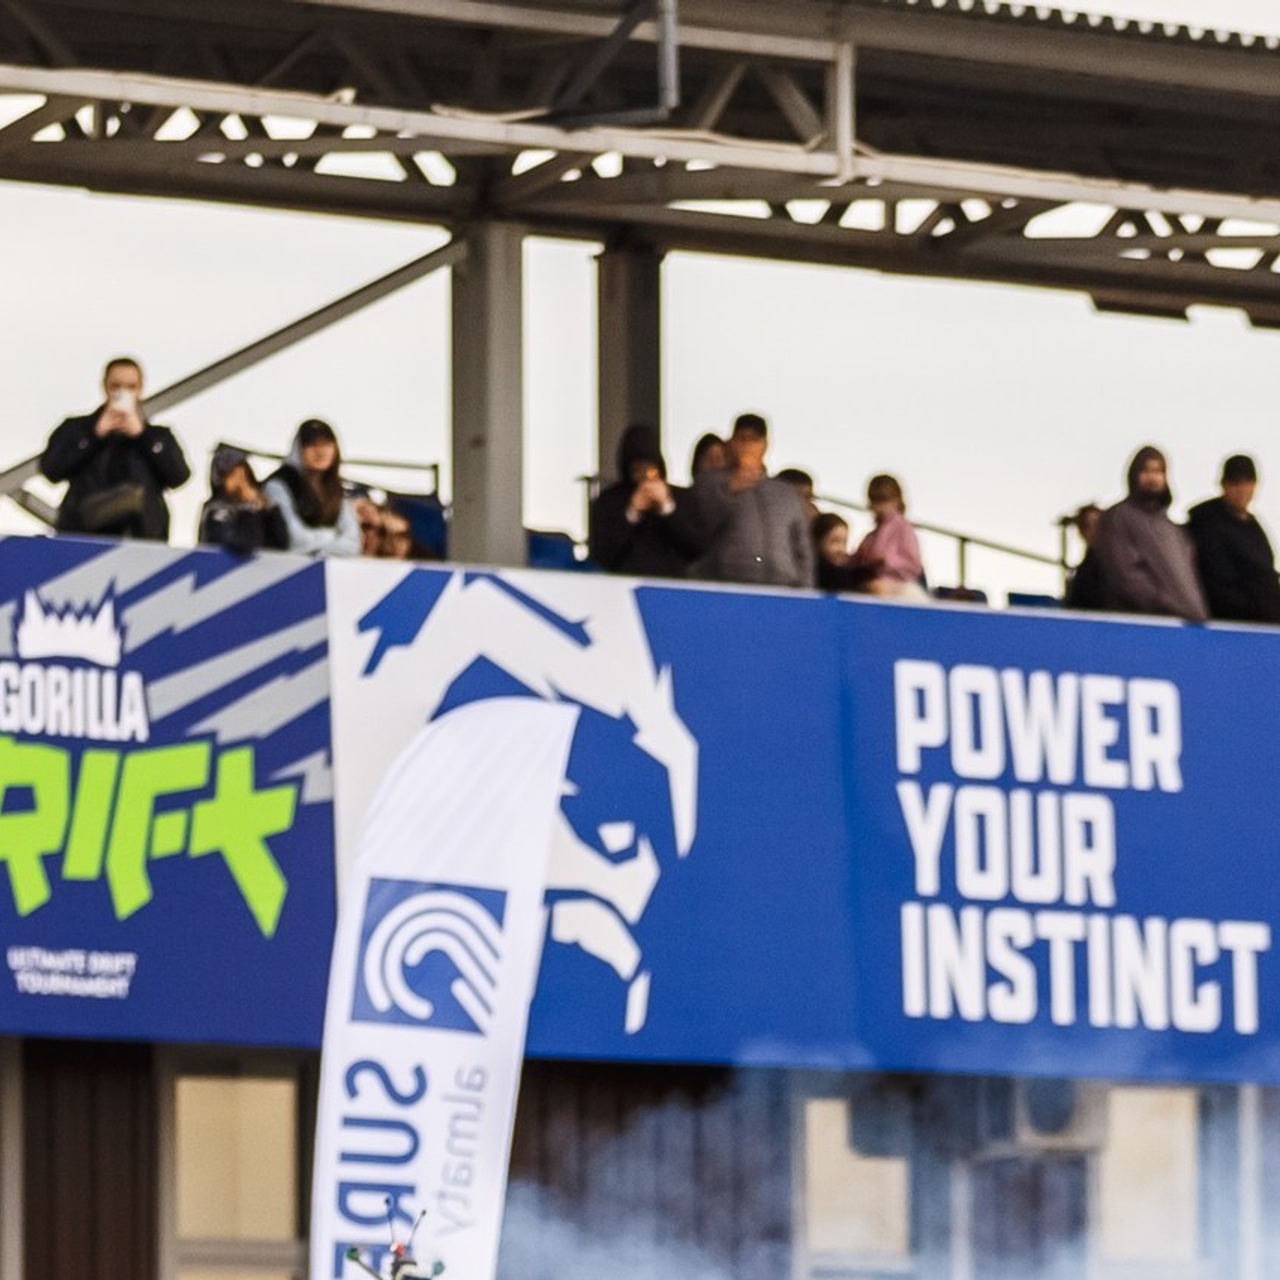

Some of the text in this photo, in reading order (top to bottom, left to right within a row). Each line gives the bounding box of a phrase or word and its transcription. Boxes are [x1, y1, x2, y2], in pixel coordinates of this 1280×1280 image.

[0, 661, 149, 743] GORILLA
[894, 658, 1183, 793] POWER
[896, 780, 1117, 908] YOUR
[900, 902, 1272, 1035] INSTINCT
